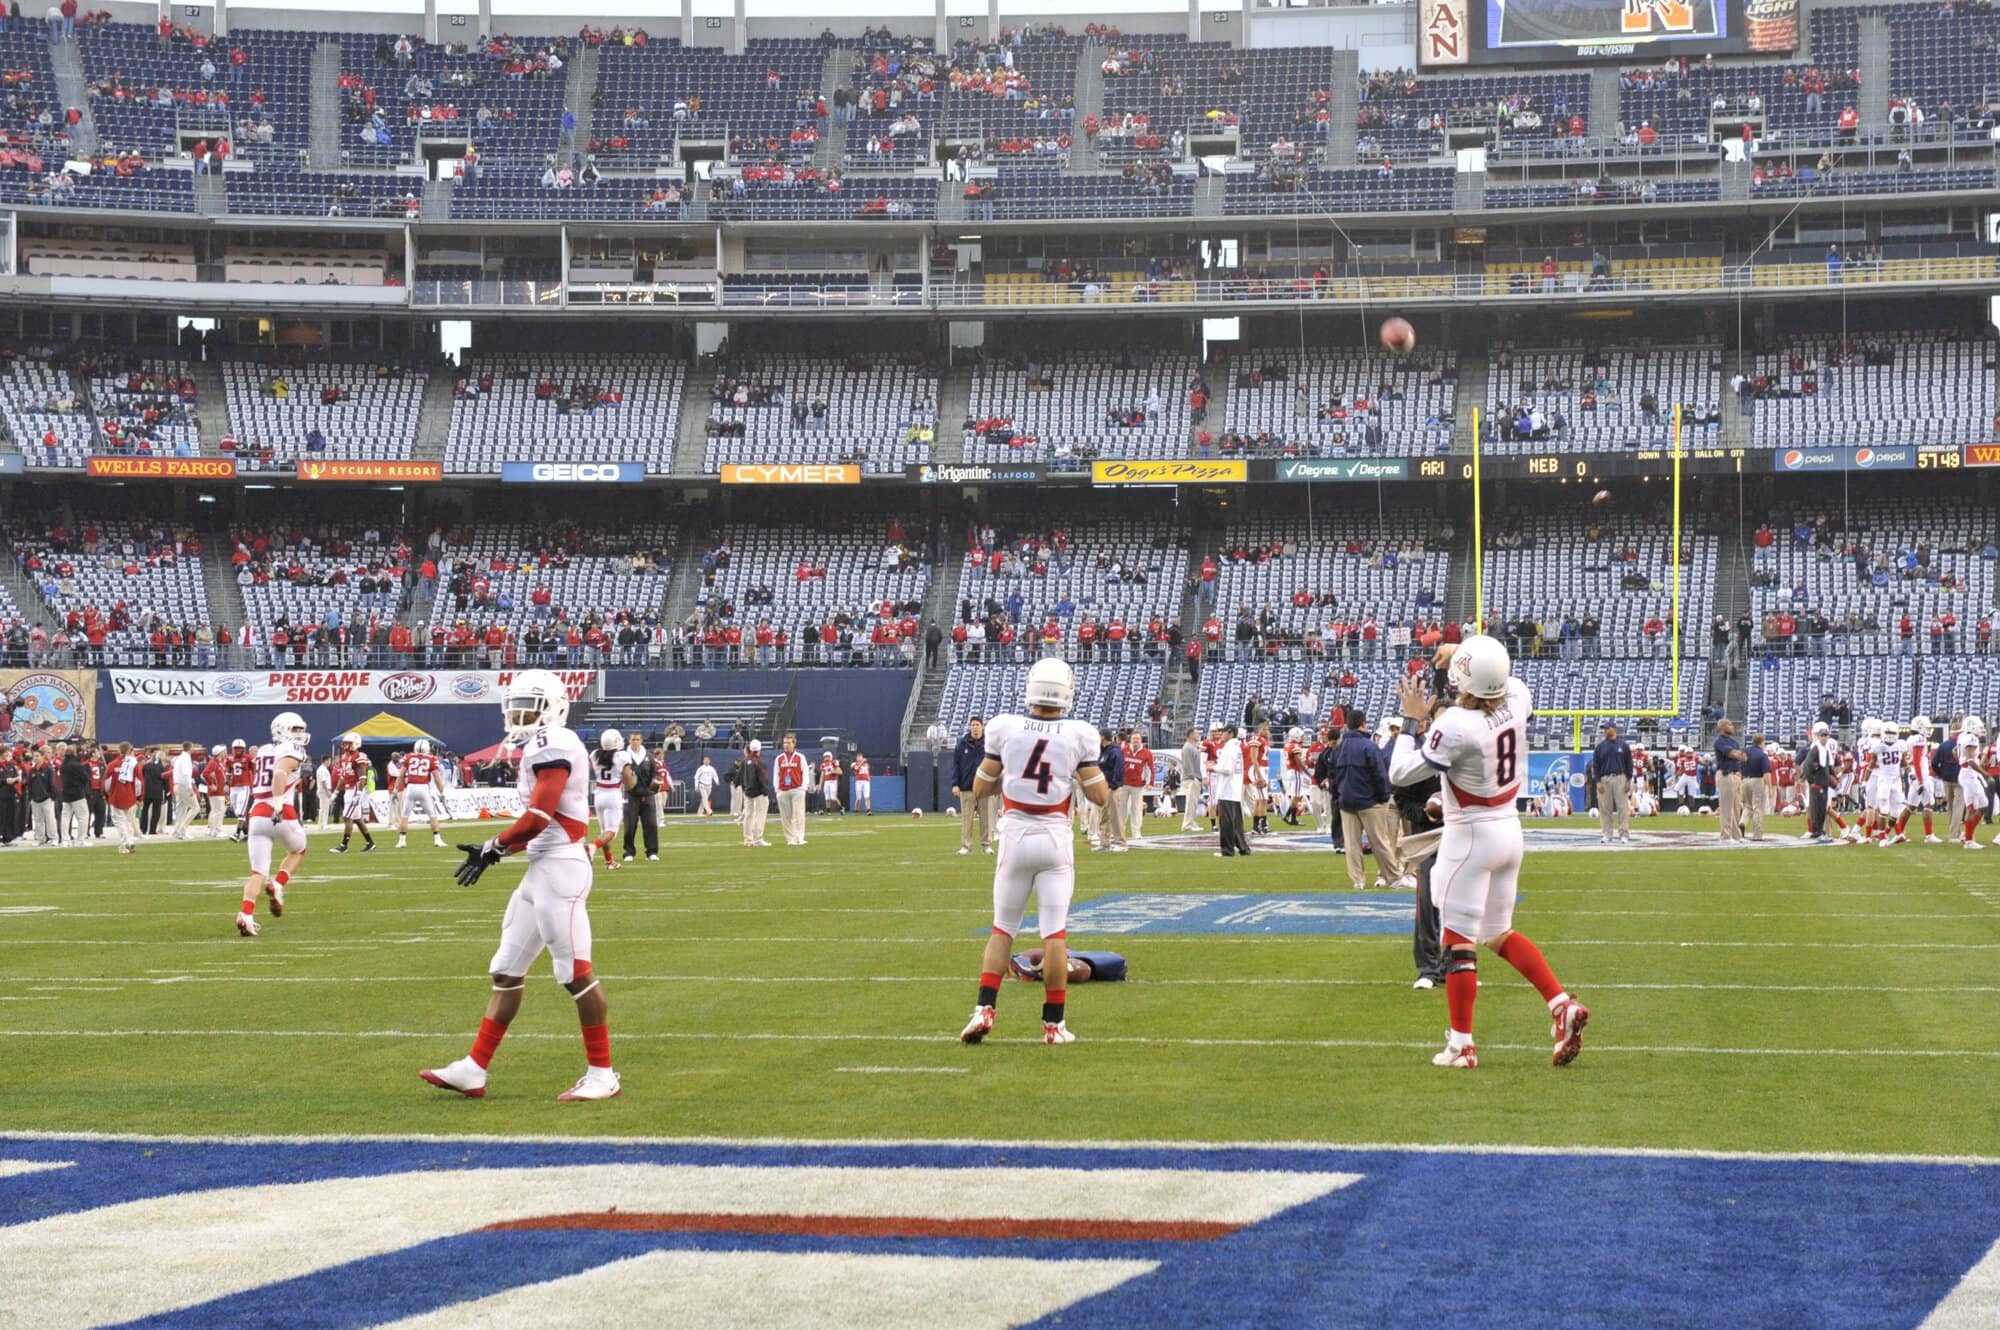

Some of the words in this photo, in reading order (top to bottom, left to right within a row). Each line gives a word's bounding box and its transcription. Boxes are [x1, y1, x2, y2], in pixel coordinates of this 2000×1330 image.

[1638, 451, 1660, 459] DOWN
[1695, 450, 1713, 458] BALL
[1714, 449, 1724, 457] ON
[1731, 449, 1745, 457] QTR
[1804, 454, 1834, 464] pepsi
[1875, 451, 1906, 463] pepsi
[93, 460, 162, 475] WELLS
[167, 461, 232, 476] FARGO
[331, 466, 382, 476] SYCUAN
[389, 466, 438, 476] RESORT
[533, 464, 620, 481] GEICO
[736, 465, 845, 482] CYMER
[938, 464, 992, 483] Brigantine
[1104, 464, 1167, 480] Oggi's
[1170, 464, 1232, 478] Pizza
[1298, 465, 1339, 478] Degree
[1360, 464, 1400, 477] Degree
[1421, 461, 1445, 476] ARI
[1463, 464, 1473, 479] 0
[1529, 458, 1559, 473] NEB
[1576, 461, 1587, 476] 0
[50, 677, 76, 697] BAND
[115, 677, 204, 696] SYCUAN
[268, 672, 370, 687] PREGAME
[402, 676, 416, 687] Dr
[286, 688, 352, 702] SHOW
[389, 679, 426, 699] Pepper
[1023, 720, 1064, 734] SCOTT
[537, 730, 548, 748] 5
[1430, 729, 1443, 751] 8
[1496, 727, 1517, 788] 8
[1882, 751, 1900, 765] 26
[231, 763, 243, 776] 6
[408, 757, 430, 776] 22
[1021, 739, 1053, 795] 4
